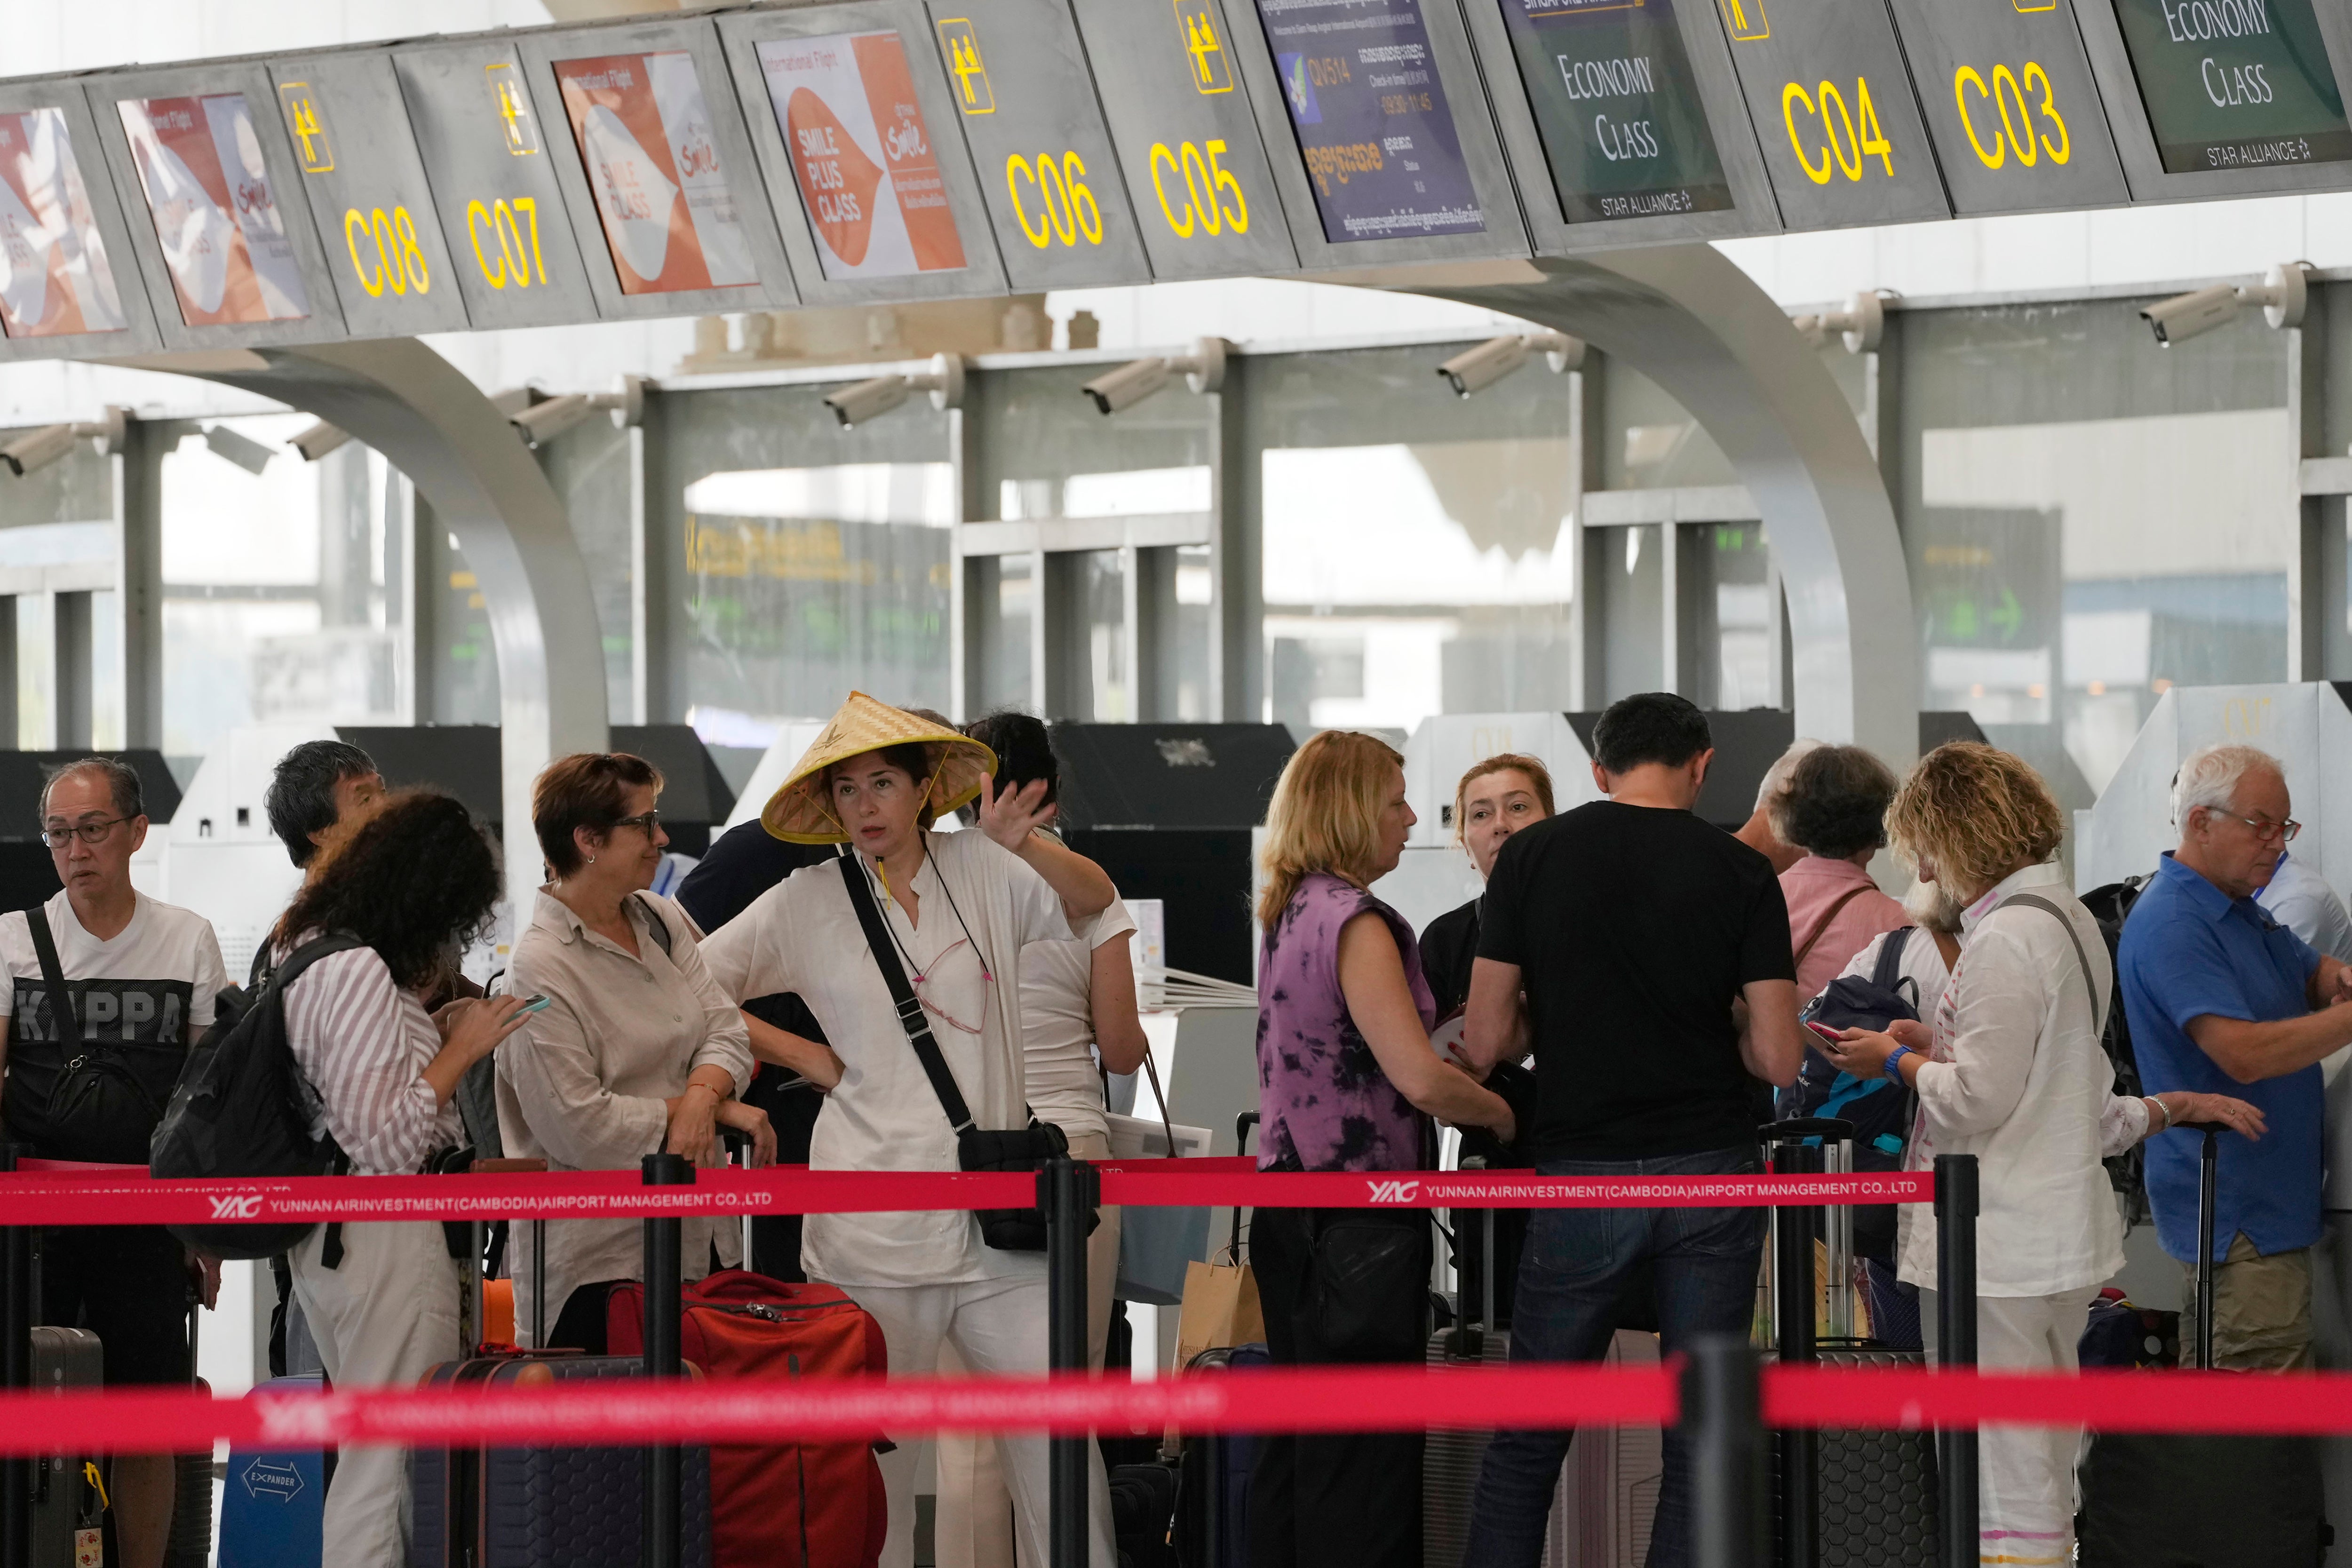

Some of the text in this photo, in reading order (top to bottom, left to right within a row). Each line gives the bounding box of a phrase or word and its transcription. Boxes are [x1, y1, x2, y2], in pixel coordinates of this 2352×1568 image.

[2161, 0, 2269, 42] ECONOMY
[1308, 57, 1351, 87] QV514
[1557, 55, 1655, 99] ECONOMY
[2202, 58, 2272, 107] CLASS
[1783, 77, 1894, 184] C04
[1955, 62, 2070, 169] C03
[798, 127, 840, 157] SMILE
[885, 119, 927, 161] Smile
[1596, 115, 1658, 161] CLASS
[2207, 141, 2298, 166] STAR ALLIANCE
[600, 162, 640, 189] SMILE
[680, 139, 719, 178] Smile
[806, 160, 844, 190] PLUS
[611, 193, 652, 221] CLASS
[818, 193, 862, 223] CLASS
[1007, 151, 1103, 248] C06
[1150, 139, 1248, 238] C05
[1602, 193, 1681, 216] STAR ALLIANCE
[345, 206, 429, 297] C08
[468, 197, 547, 289] C07
[270, 1200, 330, 1212] YUNNAN
[610, 1194, 713, 1208] MANAGEMENT
[1426, 1186, 1486, 1198] YUNNAN
[1757, 1183, 1859, 1196] MANAGEMENT
[1861, 1181, 1917, 1195] CO.,LTD
[251, 1472, 295, 1487] EXPANDER
